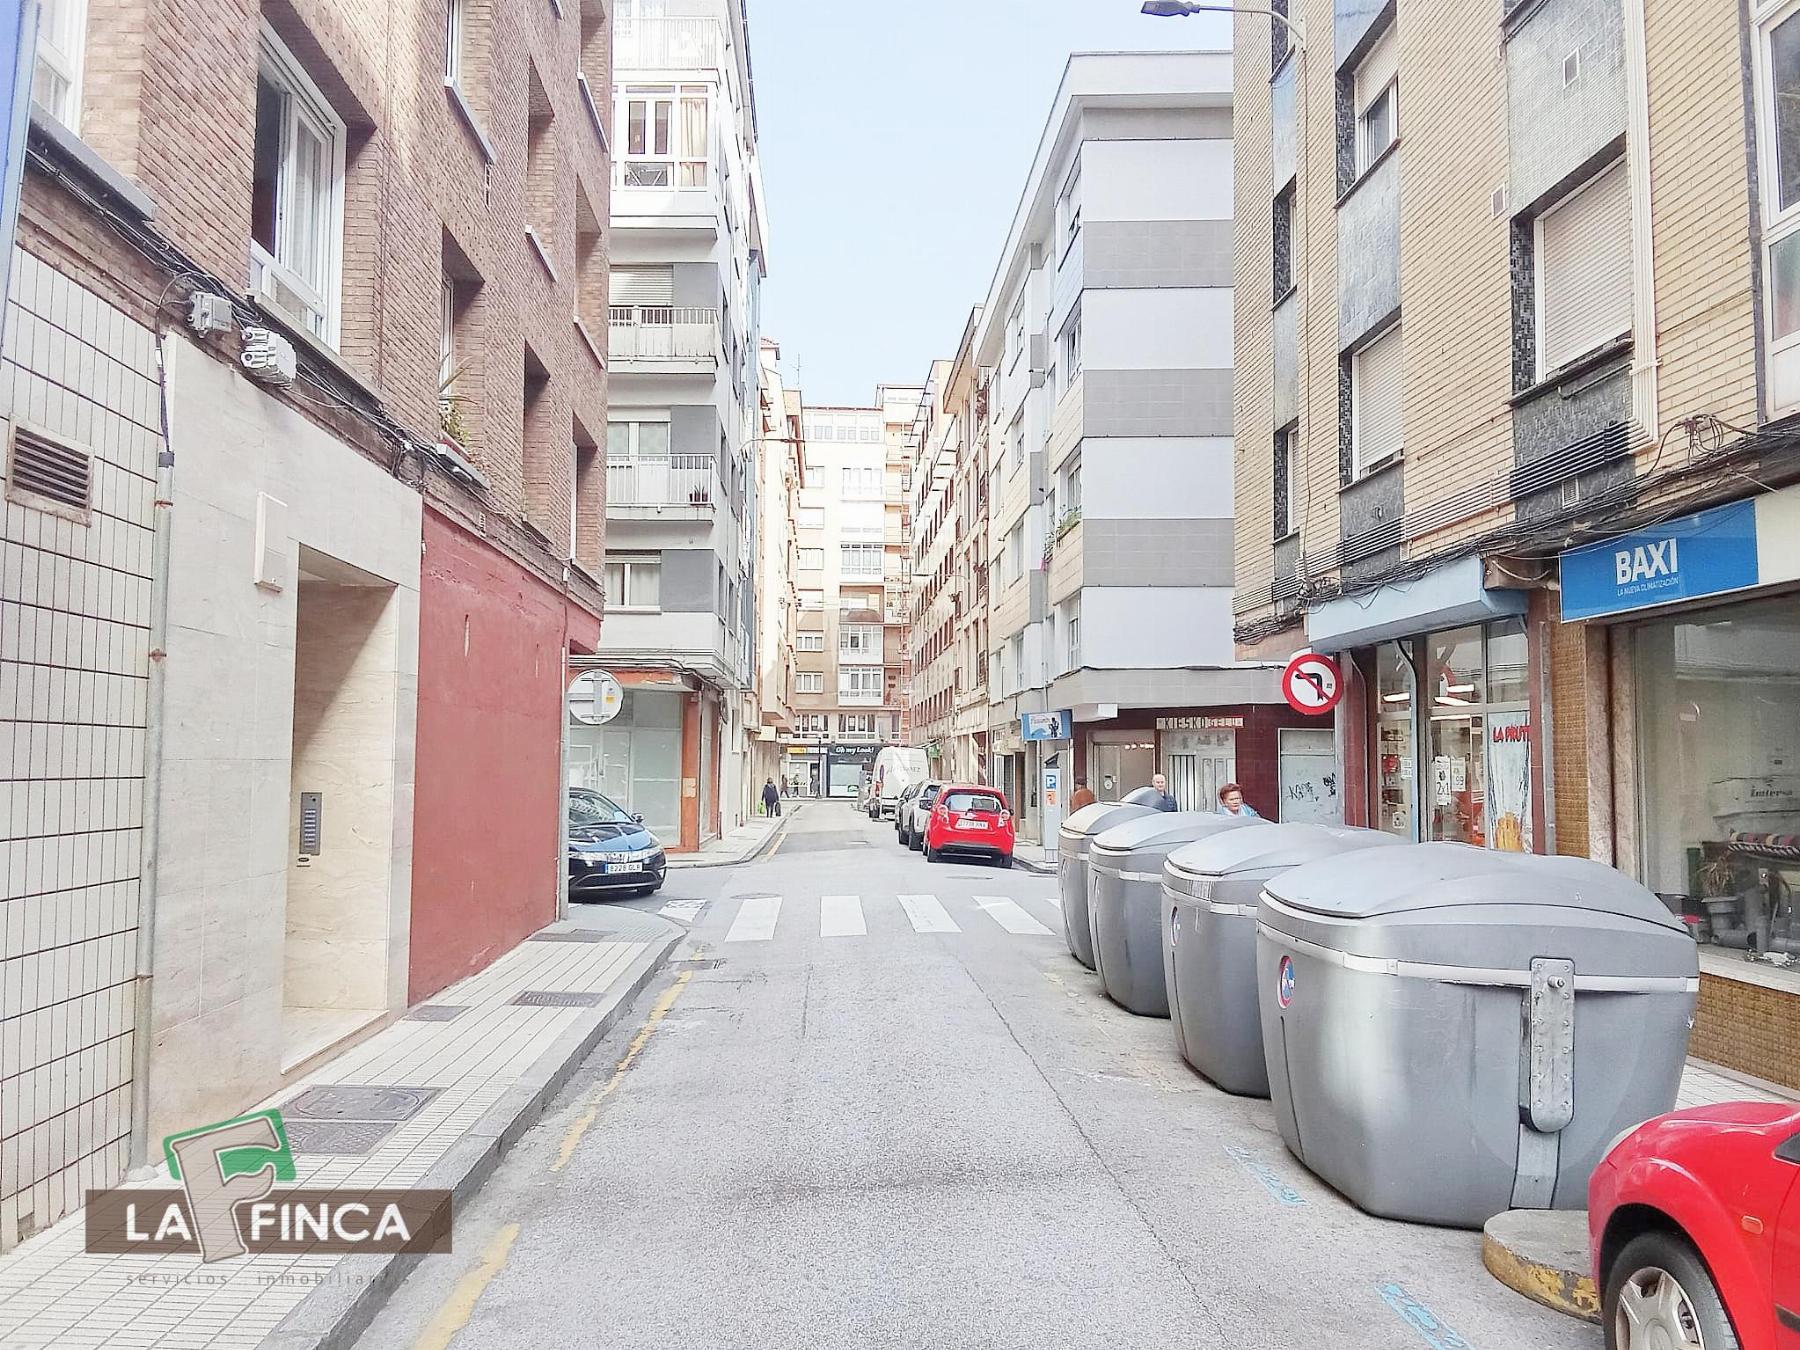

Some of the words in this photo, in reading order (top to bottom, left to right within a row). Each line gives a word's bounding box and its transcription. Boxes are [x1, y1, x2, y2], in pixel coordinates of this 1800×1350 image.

[1615, 538, 1678, 585] BAXI
[1624, 585, 1641, 595] NUEVA
[1640, 576, 1679, 592] CLIMATIZACIÓN
[1493, 726, 1504, 743] LA
[1505, 725, 1532, 743] FRUT
[836, 746, 845, 754] Oh
[1046, 777, 1056, 787] P
[1436, 781, 1450, 796] 2x1
